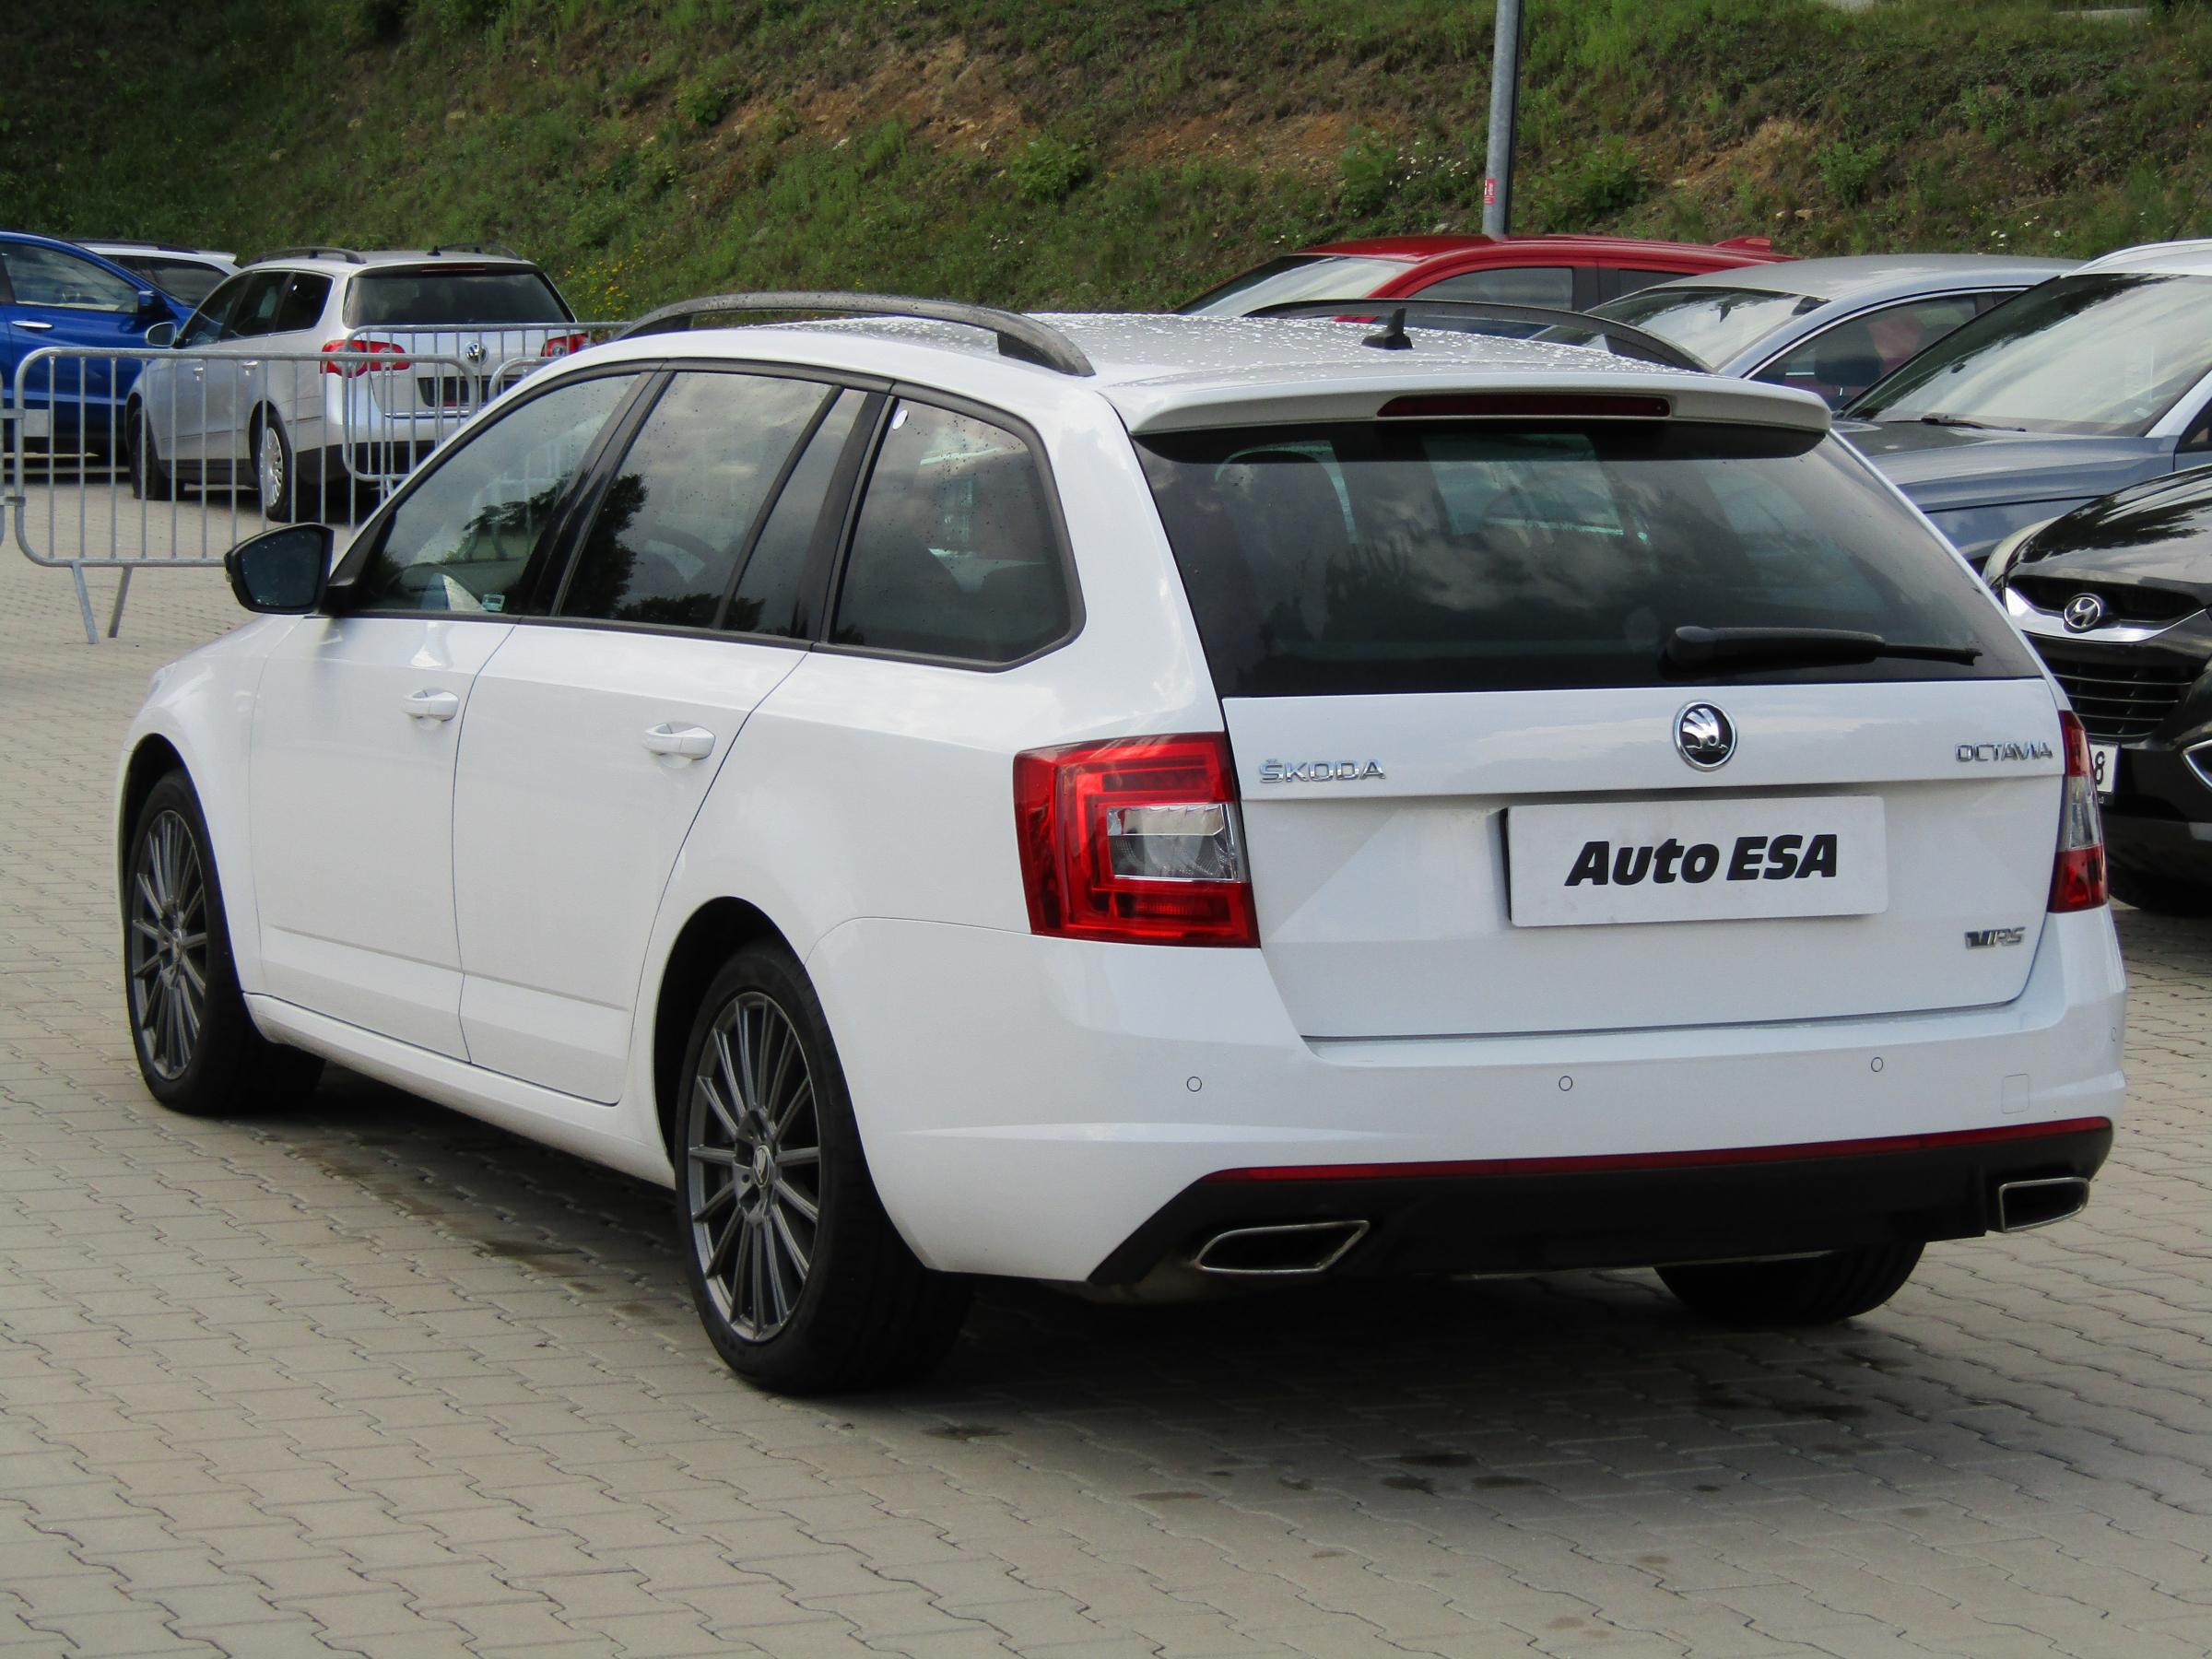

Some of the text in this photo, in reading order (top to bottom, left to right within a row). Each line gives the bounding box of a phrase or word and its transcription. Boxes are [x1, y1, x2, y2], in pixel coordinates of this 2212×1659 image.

[1955, 741, 2053, 762] OCTAVIA
[1259, 758, 1386, 783] ŠKODA
[1564, 833, 1837, 887] Auto ESA
